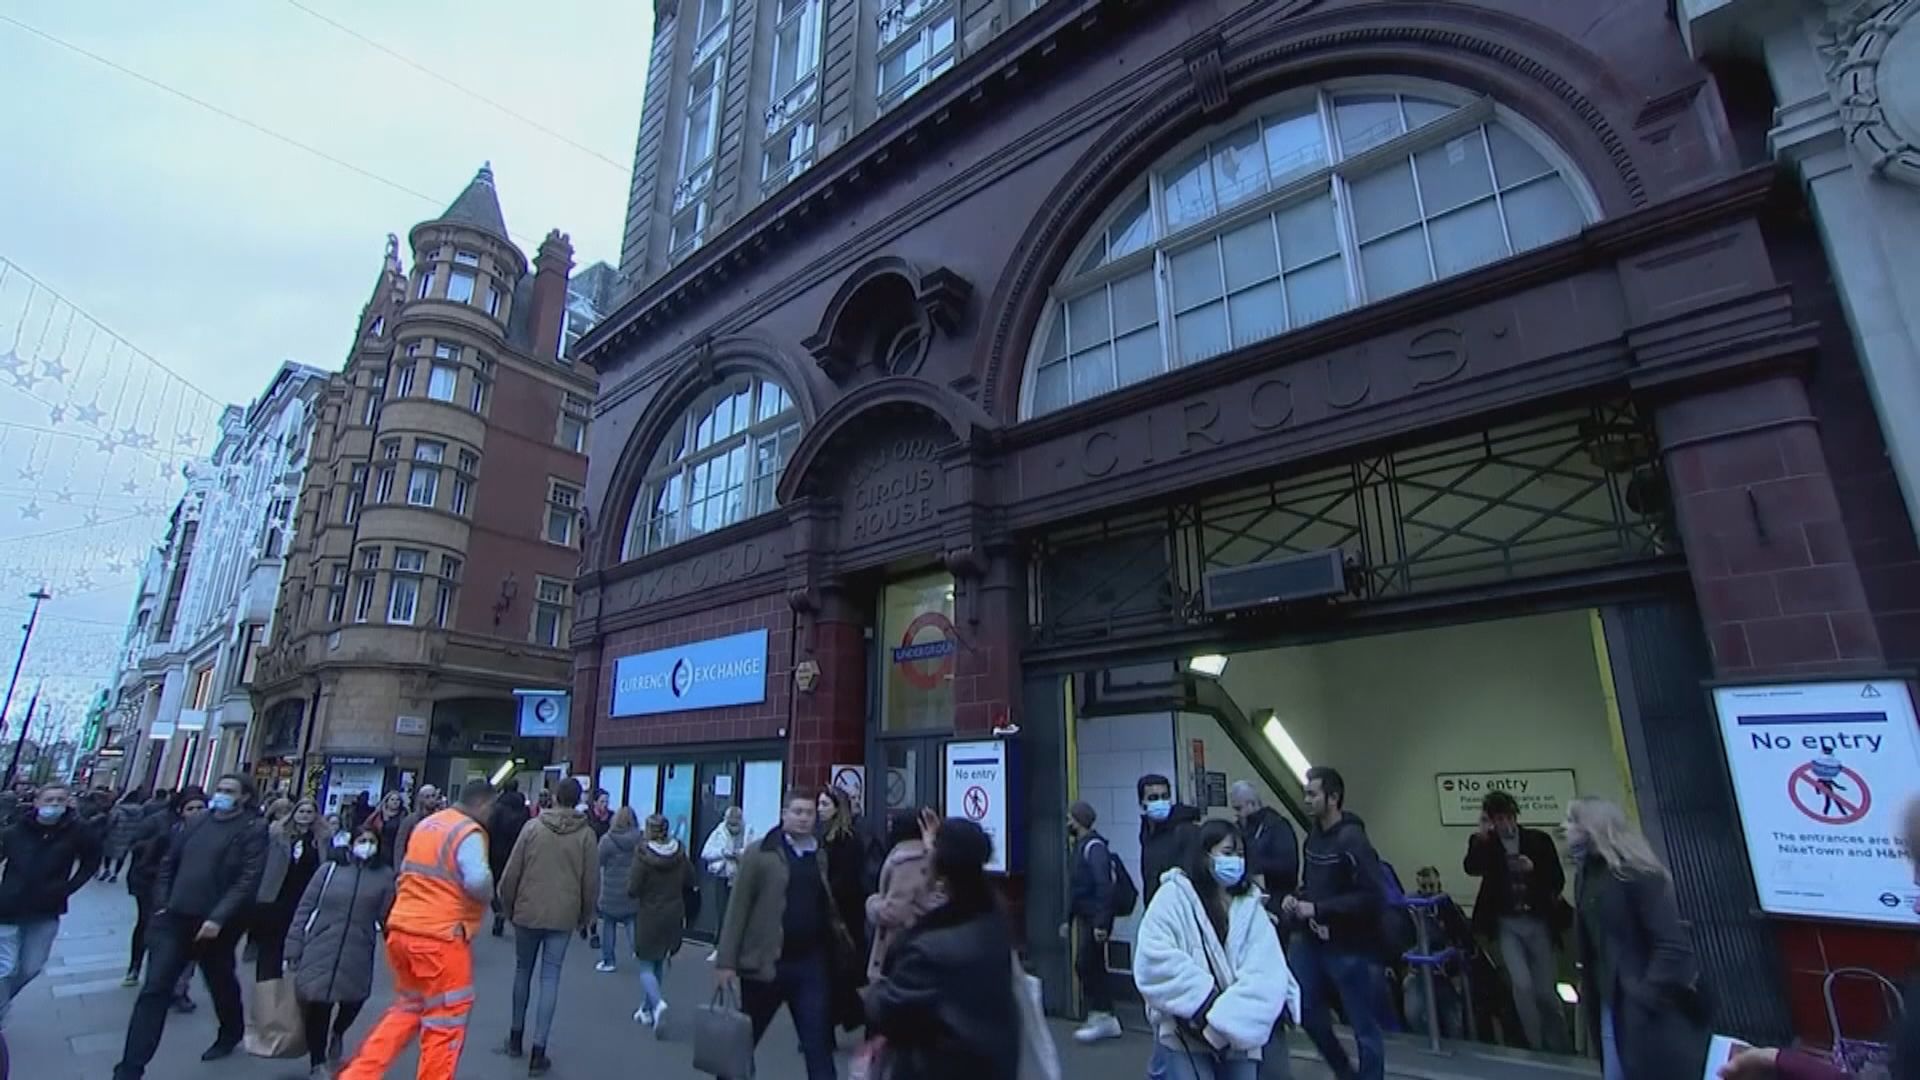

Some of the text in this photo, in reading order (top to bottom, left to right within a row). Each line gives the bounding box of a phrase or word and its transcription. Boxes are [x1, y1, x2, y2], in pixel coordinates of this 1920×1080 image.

[1081, 328, 1468, 478] CIRCUS
[855, 469, 934, 511] CIRCUS
[854, 498, 934, 541] HOUSE
[628, 544, 762, 606] OXFORD
[895, 640, 955, 661] UNDERGROU
[619, 658, 761, 694] CURRENCY EXCHANGE
[1752, 732, 1882, 753] No entry
[954, 769, 997, 782] No entry
[1458, 777, 1528, 792] No entry
[1772, 831, 1796, 842] The
[1799, 832, 1865, 846] entrances
[1868, 836, 1890, 847] are
[1778, 843, 1844, 857] NikeTown
[1847, 845, 1872, 858] and
